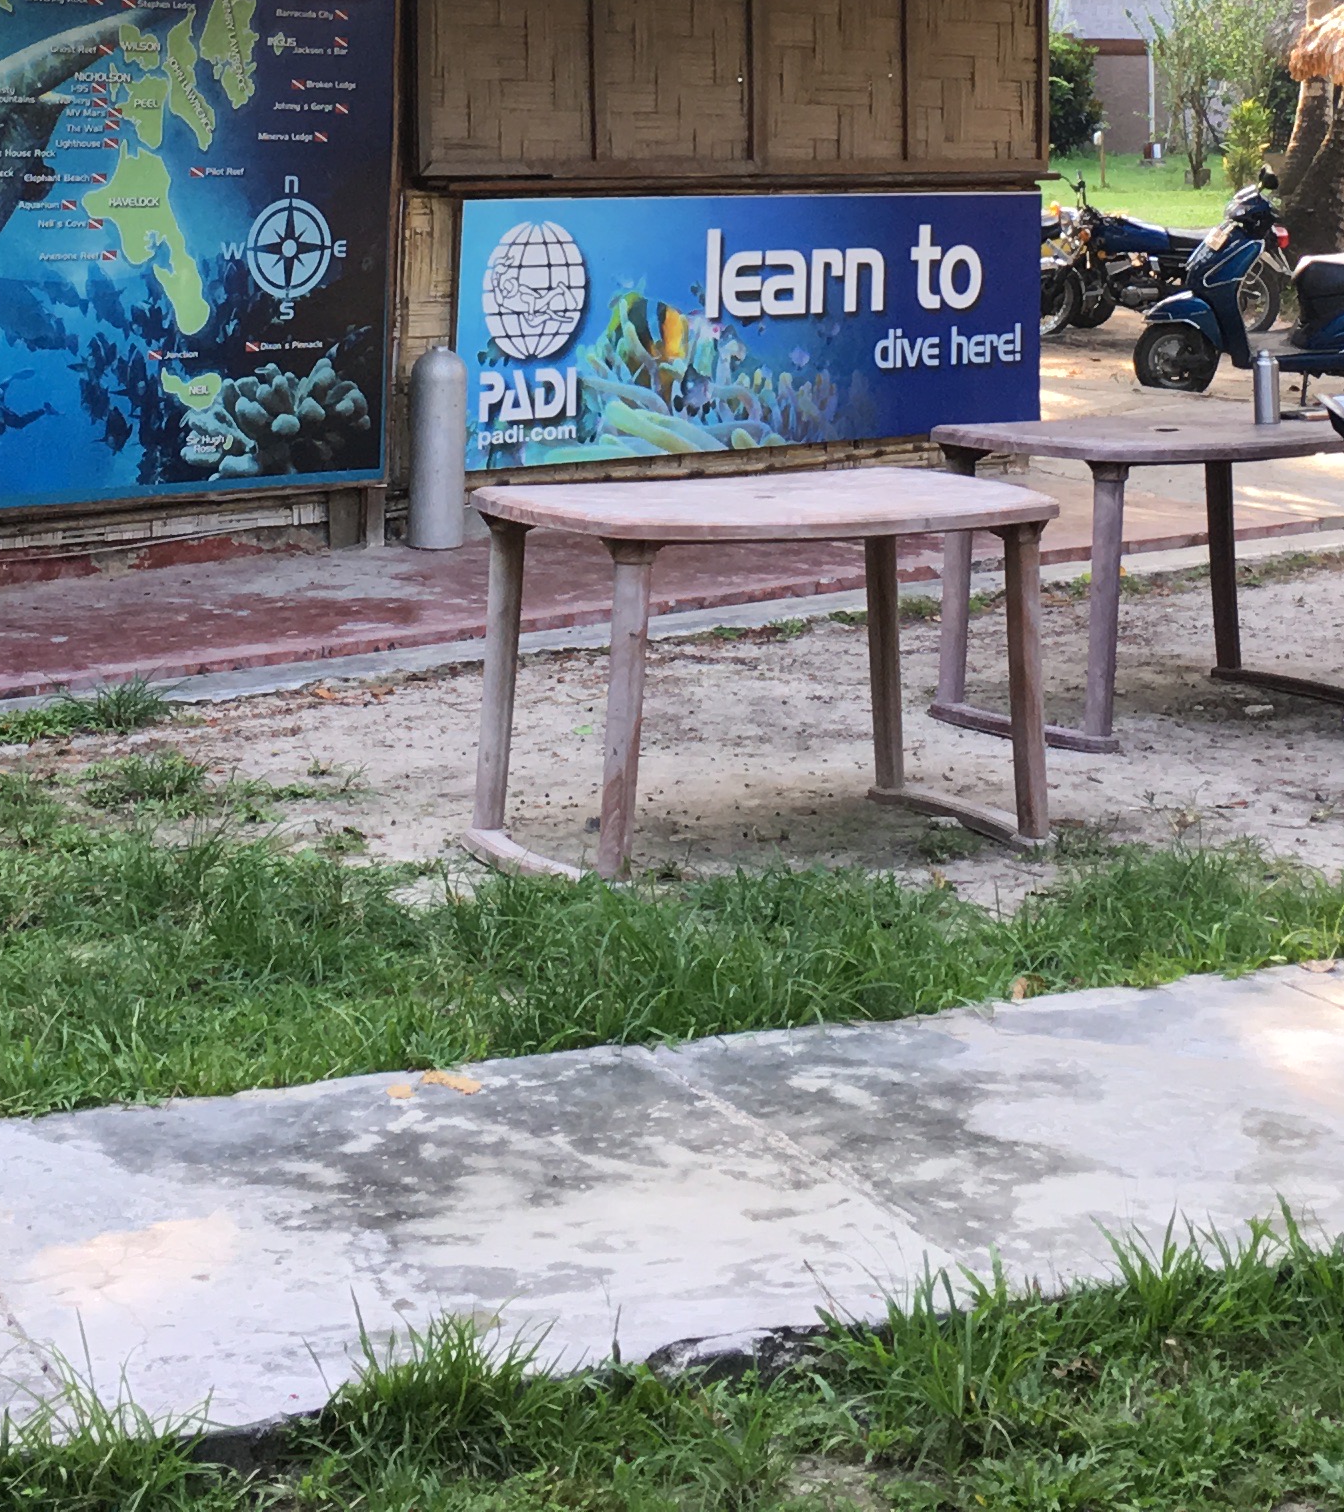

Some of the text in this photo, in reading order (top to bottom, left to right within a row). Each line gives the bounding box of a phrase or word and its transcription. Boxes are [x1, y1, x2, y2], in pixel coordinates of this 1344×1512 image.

[137, 0, 171, 9] Stephen
[276, 8, 335, 20] Barracuda City
[121, 41, 161, 52] WILSON
[334, 48, 348, 56] Bar
[228, 32, 246, 92] LAWRENCE
[74, 72, 131, 83] NICHOLSON
[306, 80, 333, 89] Broken
[166, 55, 214, 133] JOHN LAWRENCE
[134, 98, 159, 108] PEEL
[311, 102, 333, 112] Gorge
[82, 109, 106, 117] Mars
[66, 124, 104, 132] The Wall
[258, 132, 313, 142] Minerva Ledge
[56, 139, 101, 149] Lighthouse
[5, 149, 31, 157] House
[34, 149, 56, 157] Rock
[206, 167, 245, 176] Pilot Reef
[24, 173, 90, 183] Elephant Beach
[18, 200, 60, 211] Aquarium
[108, 197, 160, 207] HAVELOCK
[65, 219, 87, 228] Cove
[221, 240, 347, 260] W E
[39, 251, 100, 261] Anemone Reef
[705, 224, 982, 318] learn to
[874, 322, 1022, 369] dive here!
[164, 351, 199, 360] Junction
[189, 385, 209, 395] NEIL
[479, 367, 577, 422] PADI
[186, 435, 225, 445] Sir Hugh
[477, 423, 577, 449] padi.com
[194, 444, 217, 453] Ross
